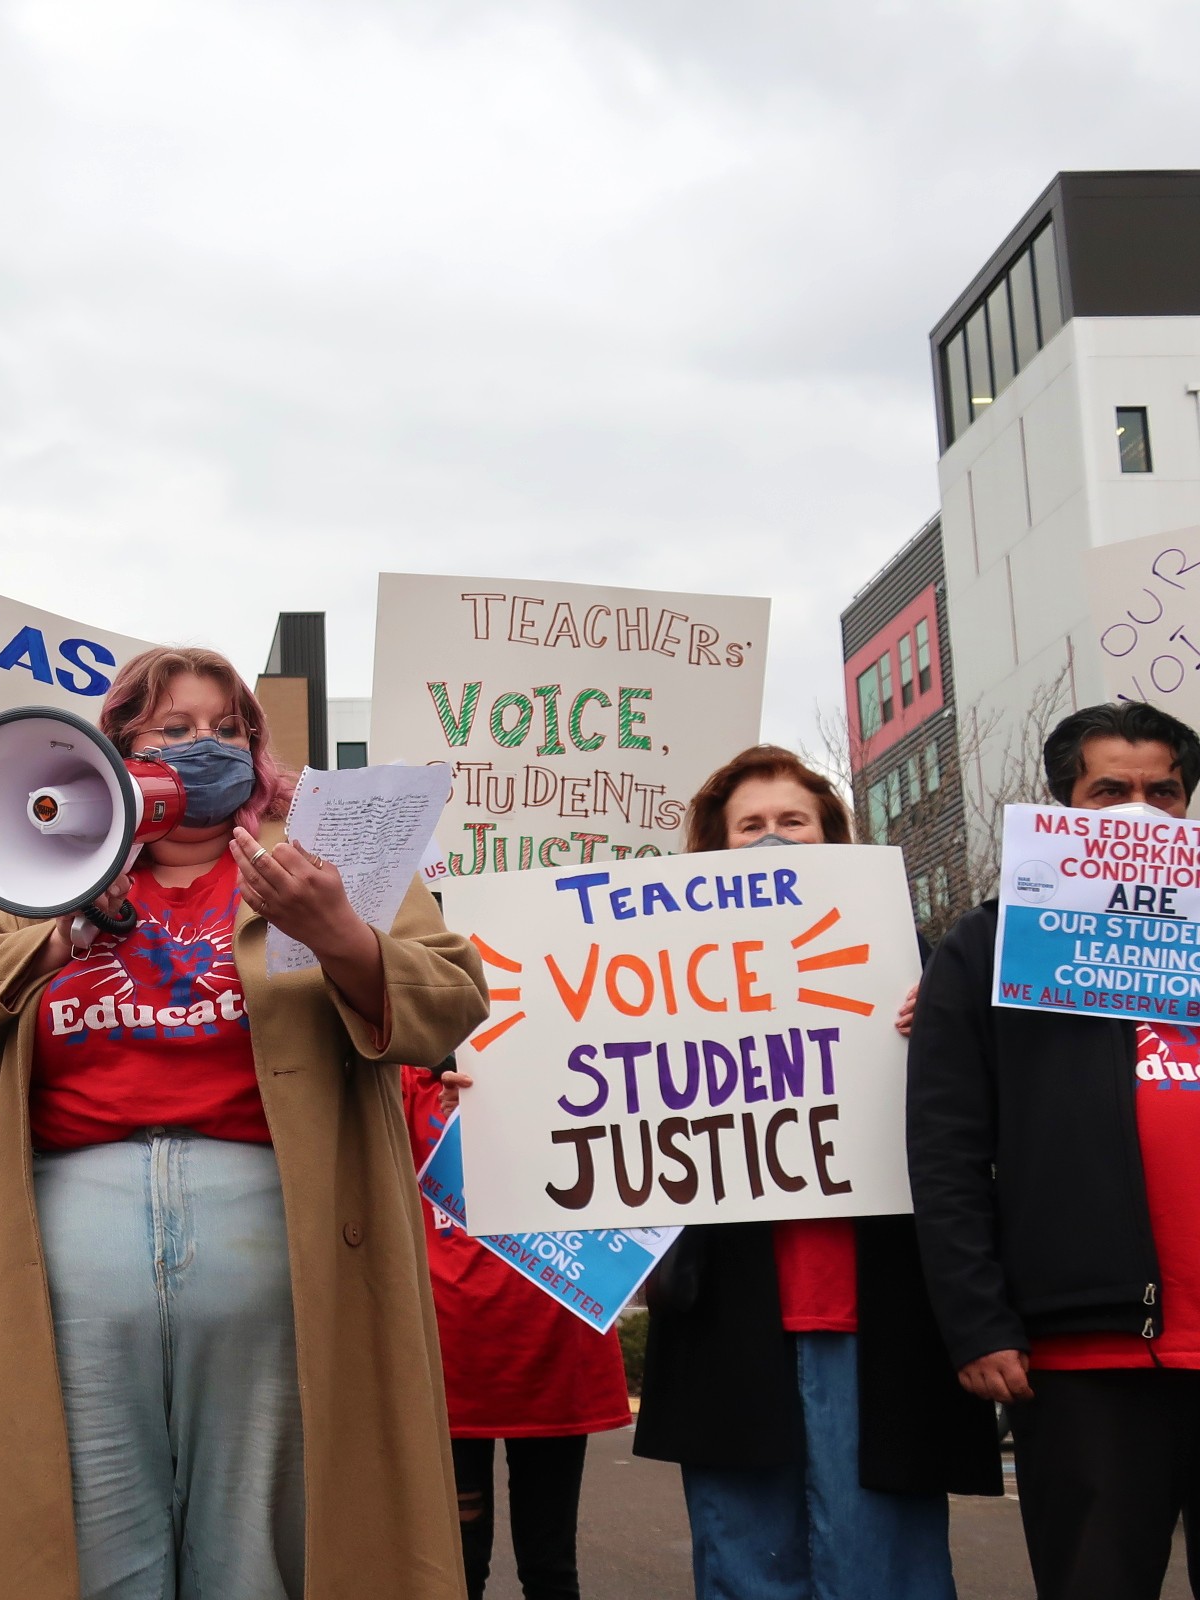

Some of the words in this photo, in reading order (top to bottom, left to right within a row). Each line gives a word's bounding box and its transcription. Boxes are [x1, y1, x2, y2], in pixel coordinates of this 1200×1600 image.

[1101, 548, 1200, 657] OUR
[426, 681, 670, 757] VOICE,
[1034, 813, 1090, 837] NAS
[1084, 838, 1200, 867] WORKIN
[424, 861, 447, 878] US
[555, 868, 803, 924] TEACHER
[1039, 911, 1097, 935] OUR
[1108, 884, 1178, 914] ARE
[544, 940, 776, 1022] VOICE
[1001, 982, 1032, 1001] WE
[1039, 987, 1076, 1006] ALL
[1083, 991, 1178, 1016] DESERVE
[557, 1027, 840, 1117] STUDENT
[545, 1104, 853, 1210] JUSTICE
[423, 1174, 443, 1198] WE
[540, 1265, 603, 1322] BETTER.
